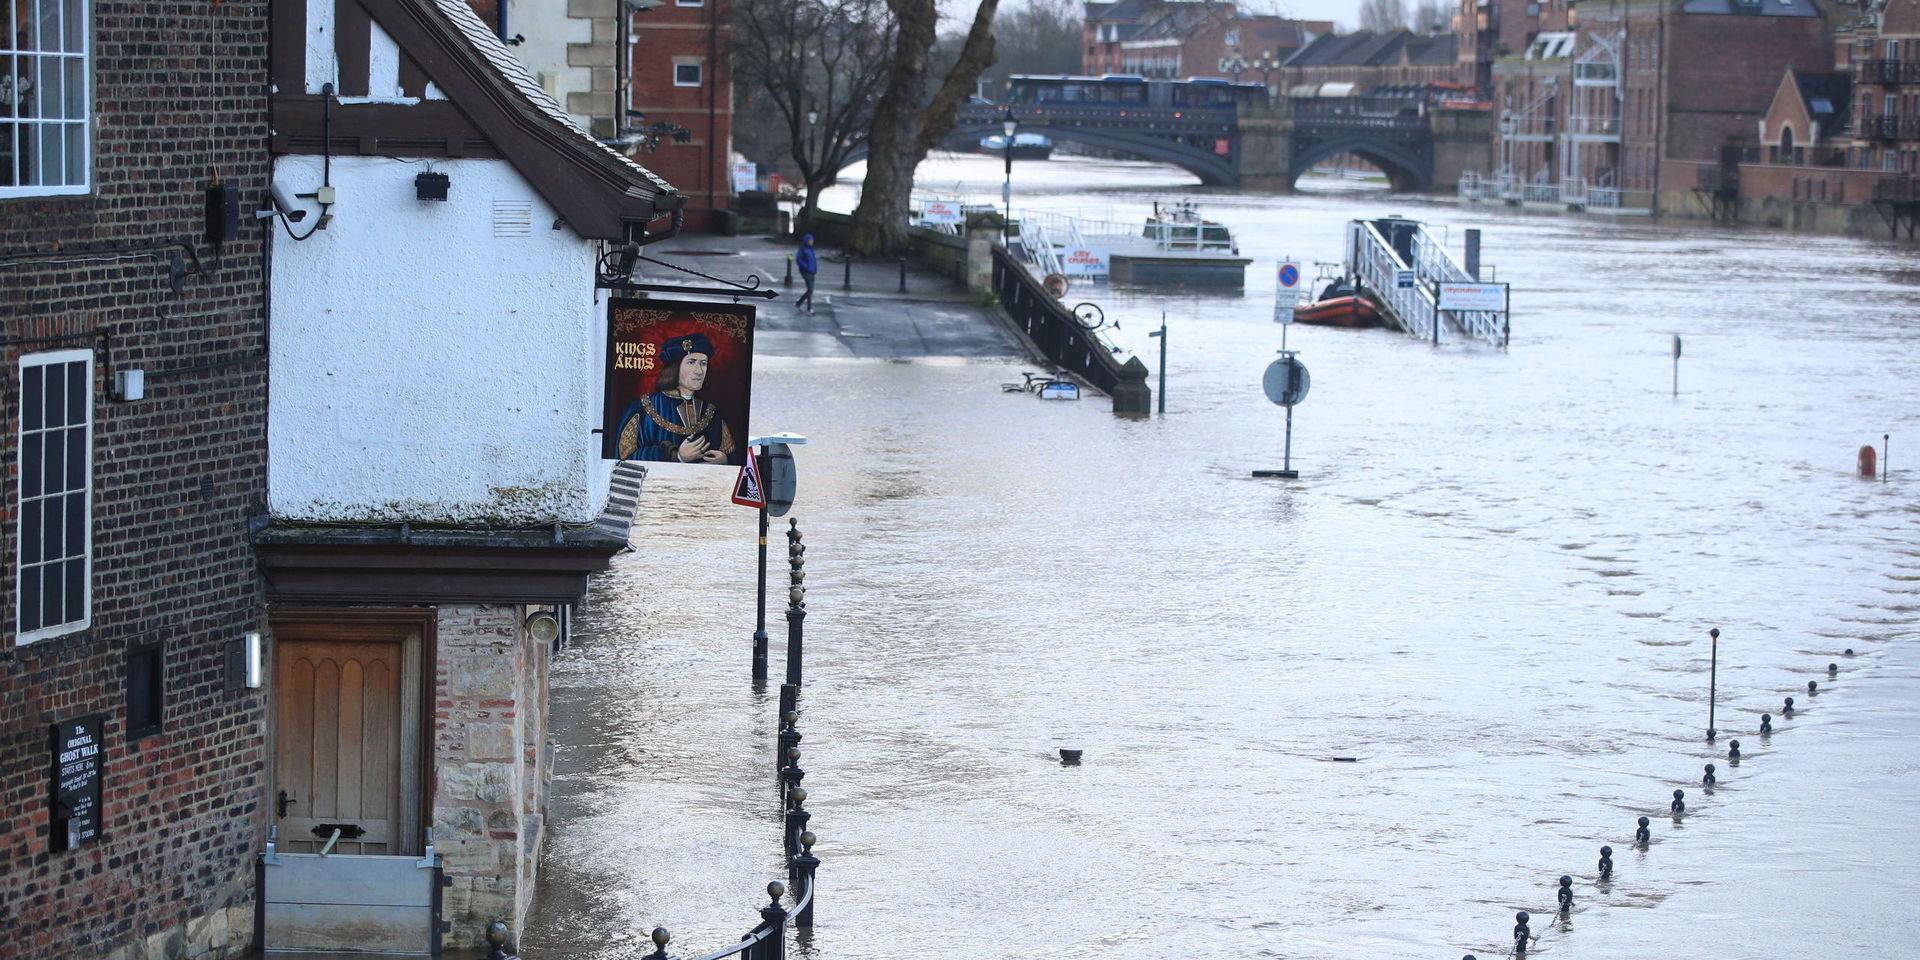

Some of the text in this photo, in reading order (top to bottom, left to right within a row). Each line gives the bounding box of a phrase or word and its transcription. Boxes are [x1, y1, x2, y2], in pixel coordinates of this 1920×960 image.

[615, 342, 656, 357] KINGS
[614, 354, 655, 371] ARMS
[75, 725, 85, 735] The
[67, 735, 92, 748] ORIGINAL
[60, 744, 98, 764] GHOST WALK
